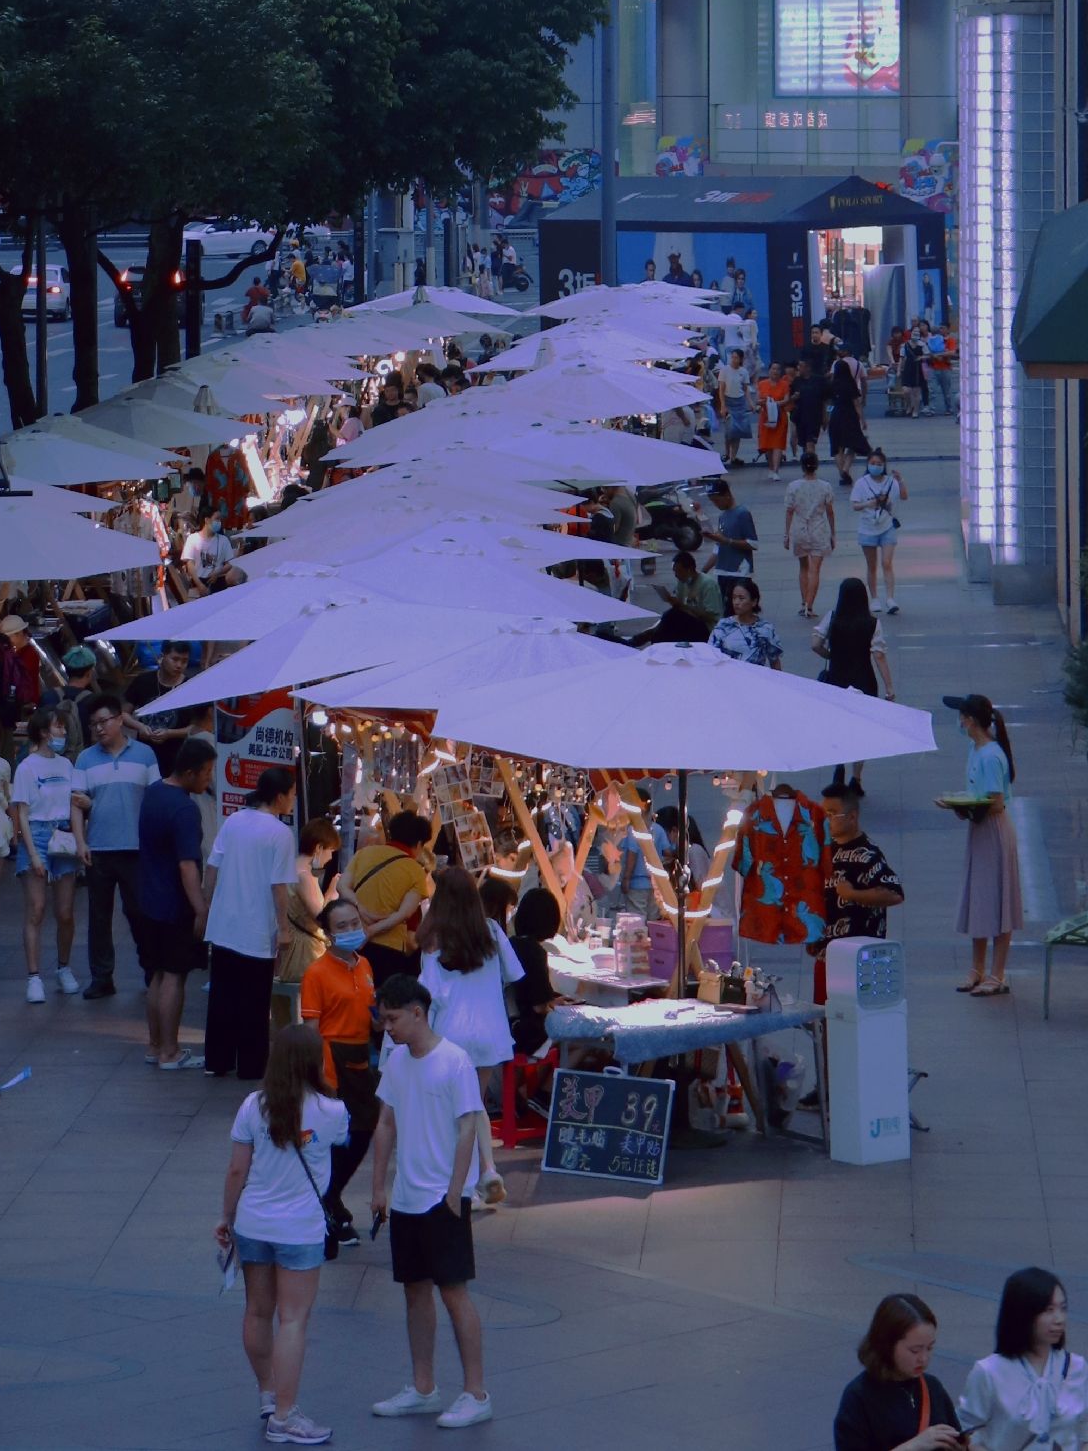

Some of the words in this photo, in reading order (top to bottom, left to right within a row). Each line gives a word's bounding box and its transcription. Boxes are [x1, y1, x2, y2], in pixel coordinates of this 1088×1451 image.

[255, 726, 294, 747] 尚德机构
[248, 743, 293, 761] 美股上市公司
[558, 1075, 605, 1126] 美甲
[619, 1131, 662, 1157] 美甲贴
